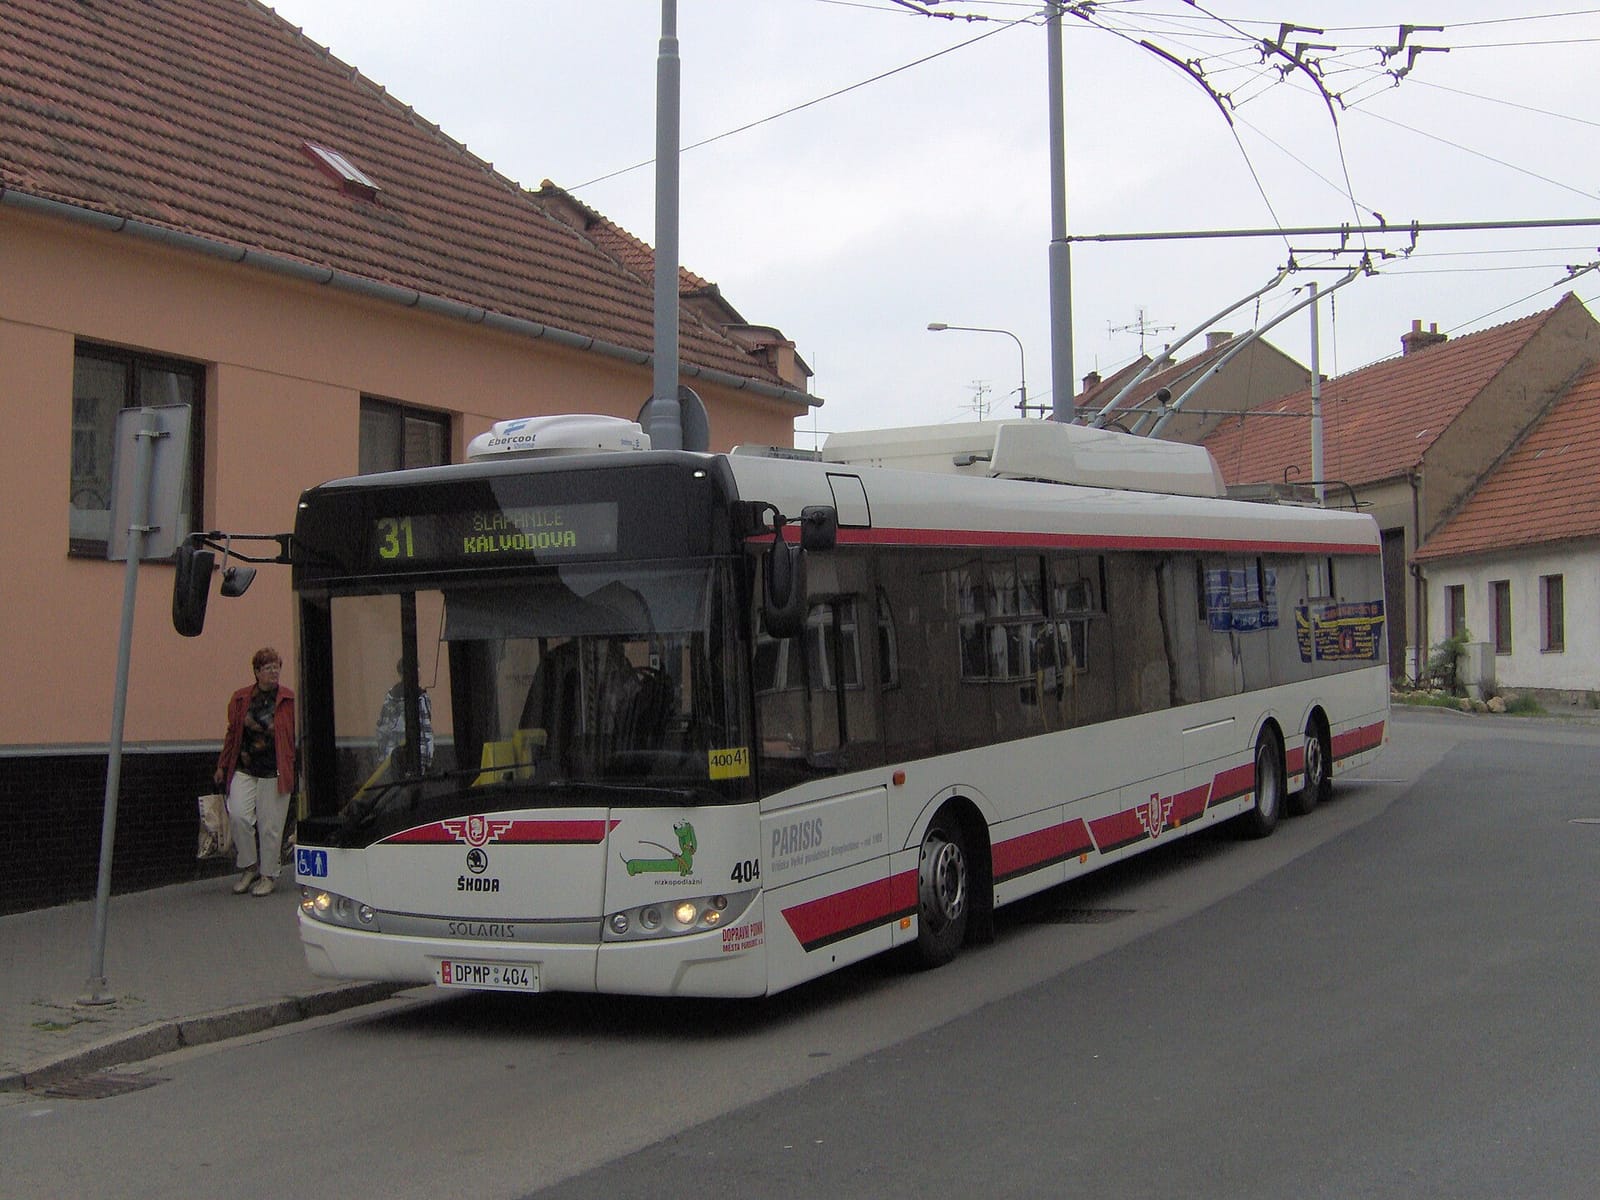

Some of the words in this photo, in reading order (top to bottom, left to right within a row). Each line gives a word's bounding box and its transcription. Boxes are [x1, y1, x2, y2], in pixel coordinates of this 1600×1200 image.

[488, 434, 536, 447] Ebercool
[378, 516, 414, 558] 31
[463, 530, 576, 553] KALVODOVA
[711, 749, 747, 767] 40041
[771, 818, 823, 858] PARISIS
[731, 859, 760, 883] 404
[457, 876, 500, 892] ŠKODA
[448, 922, 515, 938] SOLARIS
[455, 965, 490, 984] DPMP
[502, 968, 529, 986] 404
